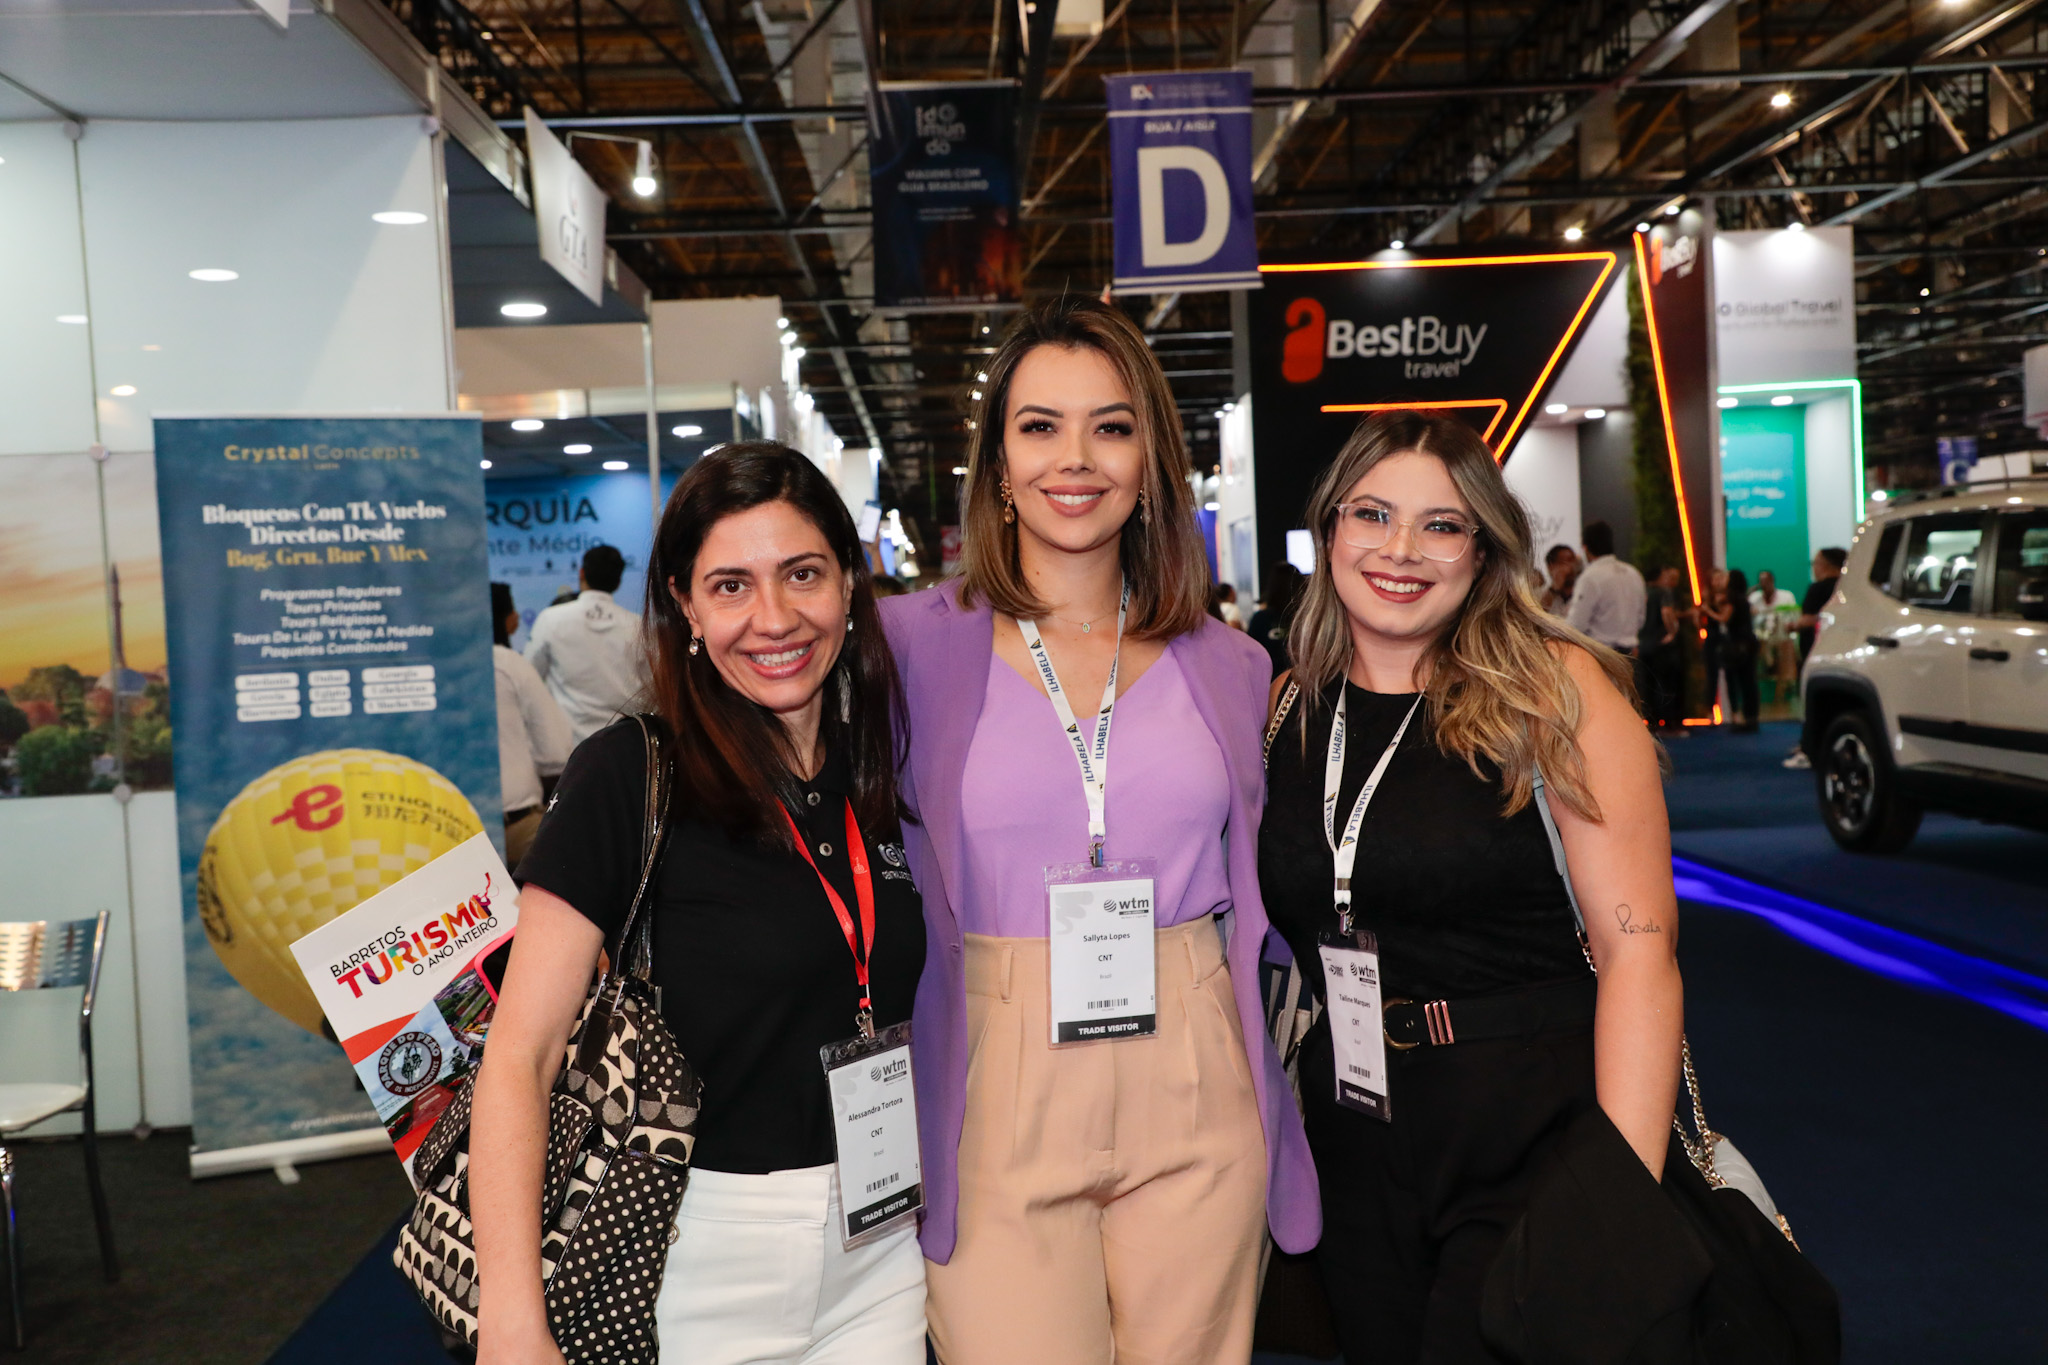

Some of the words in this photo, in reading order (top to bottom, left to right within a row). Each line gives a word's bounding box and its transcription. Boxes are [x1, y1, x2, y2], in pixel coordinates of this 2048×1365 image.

[1137, 146, 1231, 268] D
[1791, 298, 1842, 314] Travel
[1326, 315, 1488, 366] BestBuy
[1405, 360, 1460, 379] travel
[224, 444, 308, 463] Crystal
[313, 444, 420, 461] Concepts
[203, 504, 300, 528] Bloqueos
[302, 503, 344, 522] Con
[347, 501, 376, 520] Tk
[380, 500, 446, 520] Vuelos
[250, 525, 340, 544] Directos
[343, 522, 405, 542] Desde
[260, 588, 335, 602] Programas
[336, 585, 402, 599] Regulares
[284, 601, 322, 614] Tours
[323, 600, 382, 612] Privados
[280, 616, 318, 628] Tours
[319, 614, 387, 627] Religiosos
[233, 632, 271, 645] Tours
[272, 631, 291, 643] De
[292, 630, 323, 644] Lujo
[328, 629, 338, 640] Y
[340, 627, 373, 642] Viaje
[374, 626, 385, 638] A
[387, 625, 434, 637] Medida
[261, 644, 325, 659] Paquetes
[326, 640, 408, 655] Combinados
[1036, 651, 1060, 692] ILHABELA
[1095, 715, 1109, 759] ILHABELA
[1331, 721, 1344, 762] ILHABELA
[1073, 736, 1095, 782] ILHABELA
[1348, 785, 1373, 832] ILHABELA
[1119, 897, 1149, 909] wtm
[336, 894, 493, 999] TURISMO
[412, 963, 424, 975] O
[428, 945, 454, 968] ANO
[454, 916, 497, 949] INTEIRO
[1083, 934, 1108, 943] Sallyta
[1109, 933, 1130, 942] Lopes
[330, 926, 405, 977] BARRETOS
[1098, 954, 1112, 962] CNT
[1358, 964, 1376, 979] wtm
[1353, 997, 1371, 1009] Marques
[1078, 1025, 1106, 1036] TRADE
[1107, 1022, 1139, 1034] VISITOR
[379, 1041, 398, 1088] PARQUE
[397, 1033, 415, 1045] DO
[882, 1059, 907, 1076] wtm
[1345, 1088, 1360, 1101] TRADE
[848, 1105, 881, 1123] Alessandra
[881, 1097, 903, 1113] Tortora
[870, 1127, 884, 1138] CNT
[861, 1208, 883, 1224] TRADE
[884, 1197, 908, 1216] VISITOR
